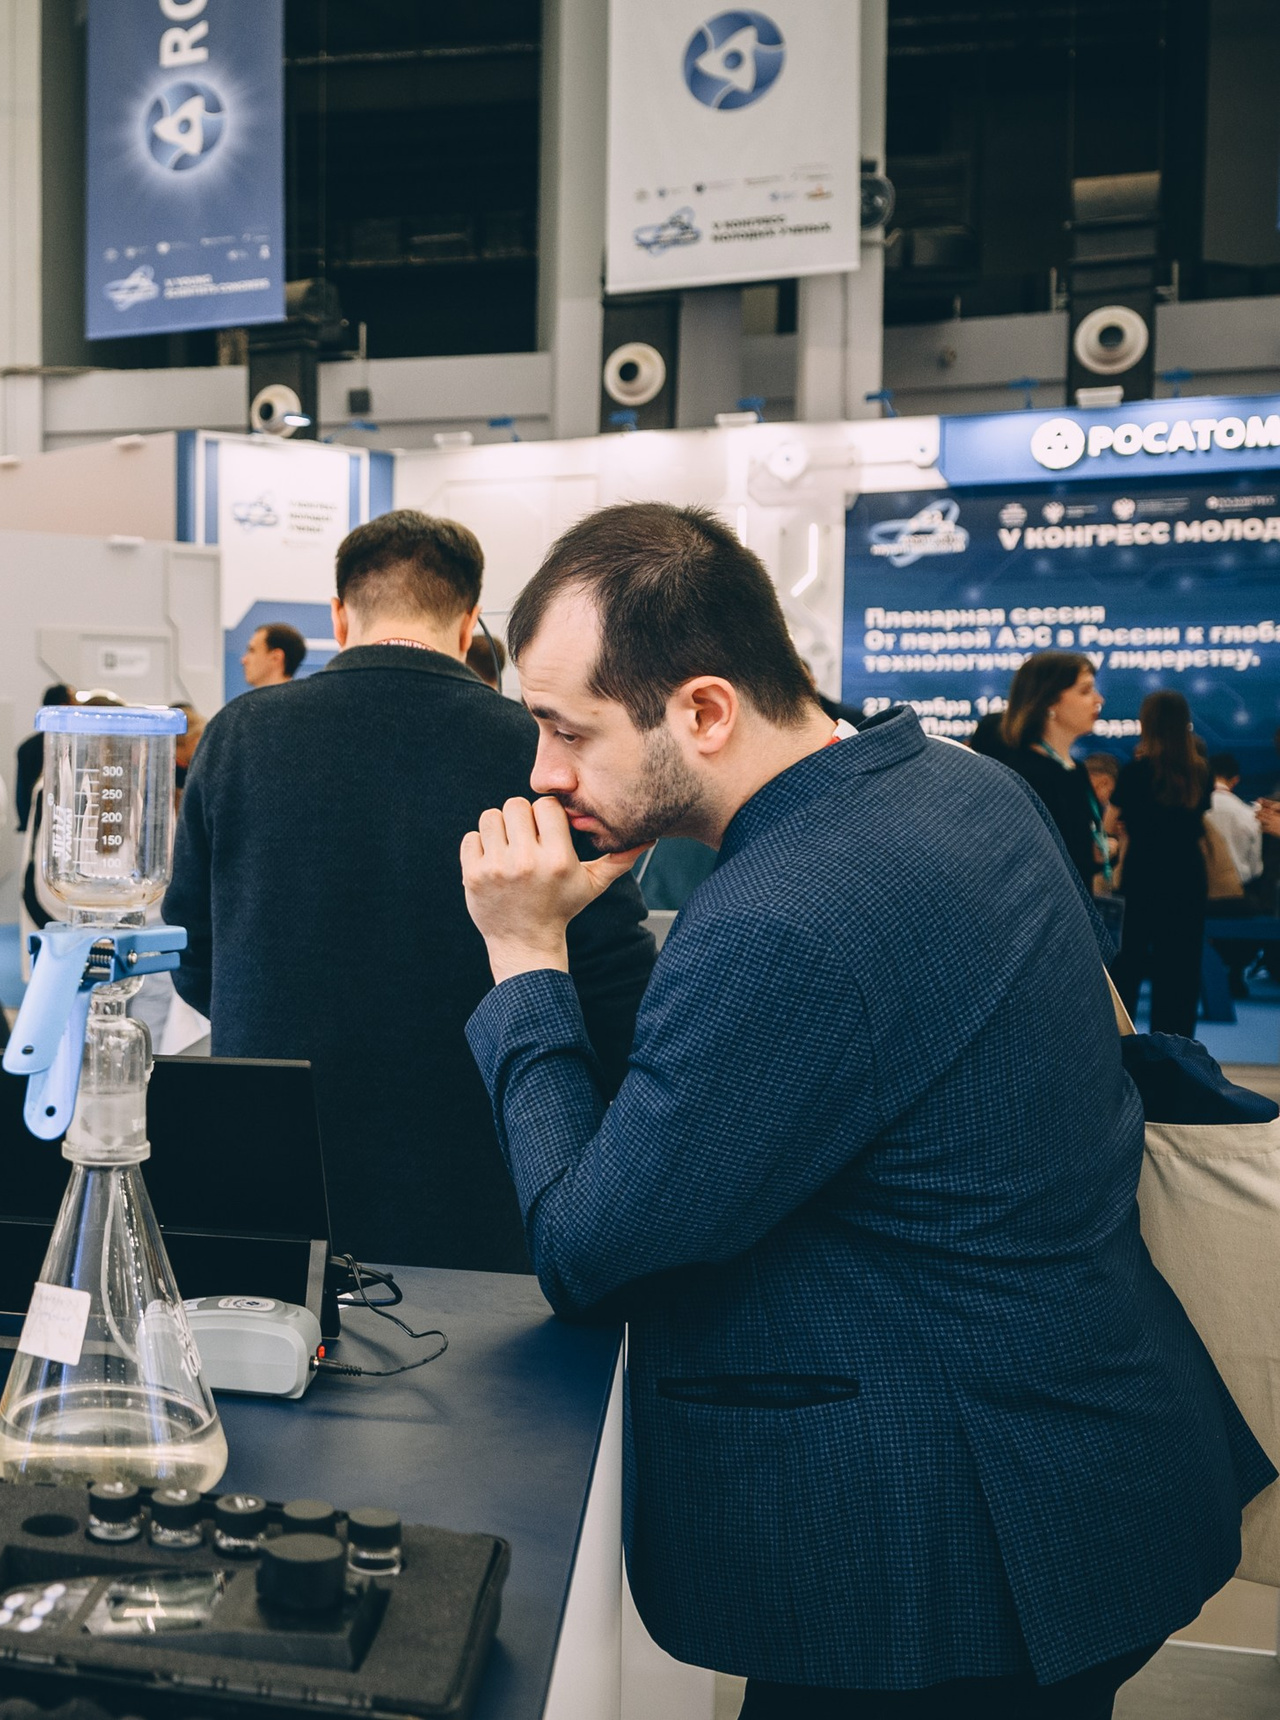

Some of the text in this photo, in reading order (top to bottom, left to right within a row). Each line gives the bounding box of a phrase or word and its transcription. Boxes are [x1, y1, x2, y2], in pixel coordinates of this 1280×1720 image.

[1088, 415, 1280, 457] РОСАТОМ
[998, 528, 1021, 550] V
[1024, 521, 1170, 549] КОНГРЕСС
[865, 606, 1105, 630] Пленарная сессия
[864, 629, 897, 651] От
[899, 627, 991, 653] первой
[995, 626, 1053, 649] АЭС
[1057, 629, 1074, 647] в
[1079, 625, 1180, 647] России
[1185, 627, 1204, 644] к
[103, 766, 123, 776] 300
[102, 789, 122, 800] 250
[101, 812, 122, 823] 200
[102, 835, 122, 846] 150
[102, 858, 121, 868] 100
